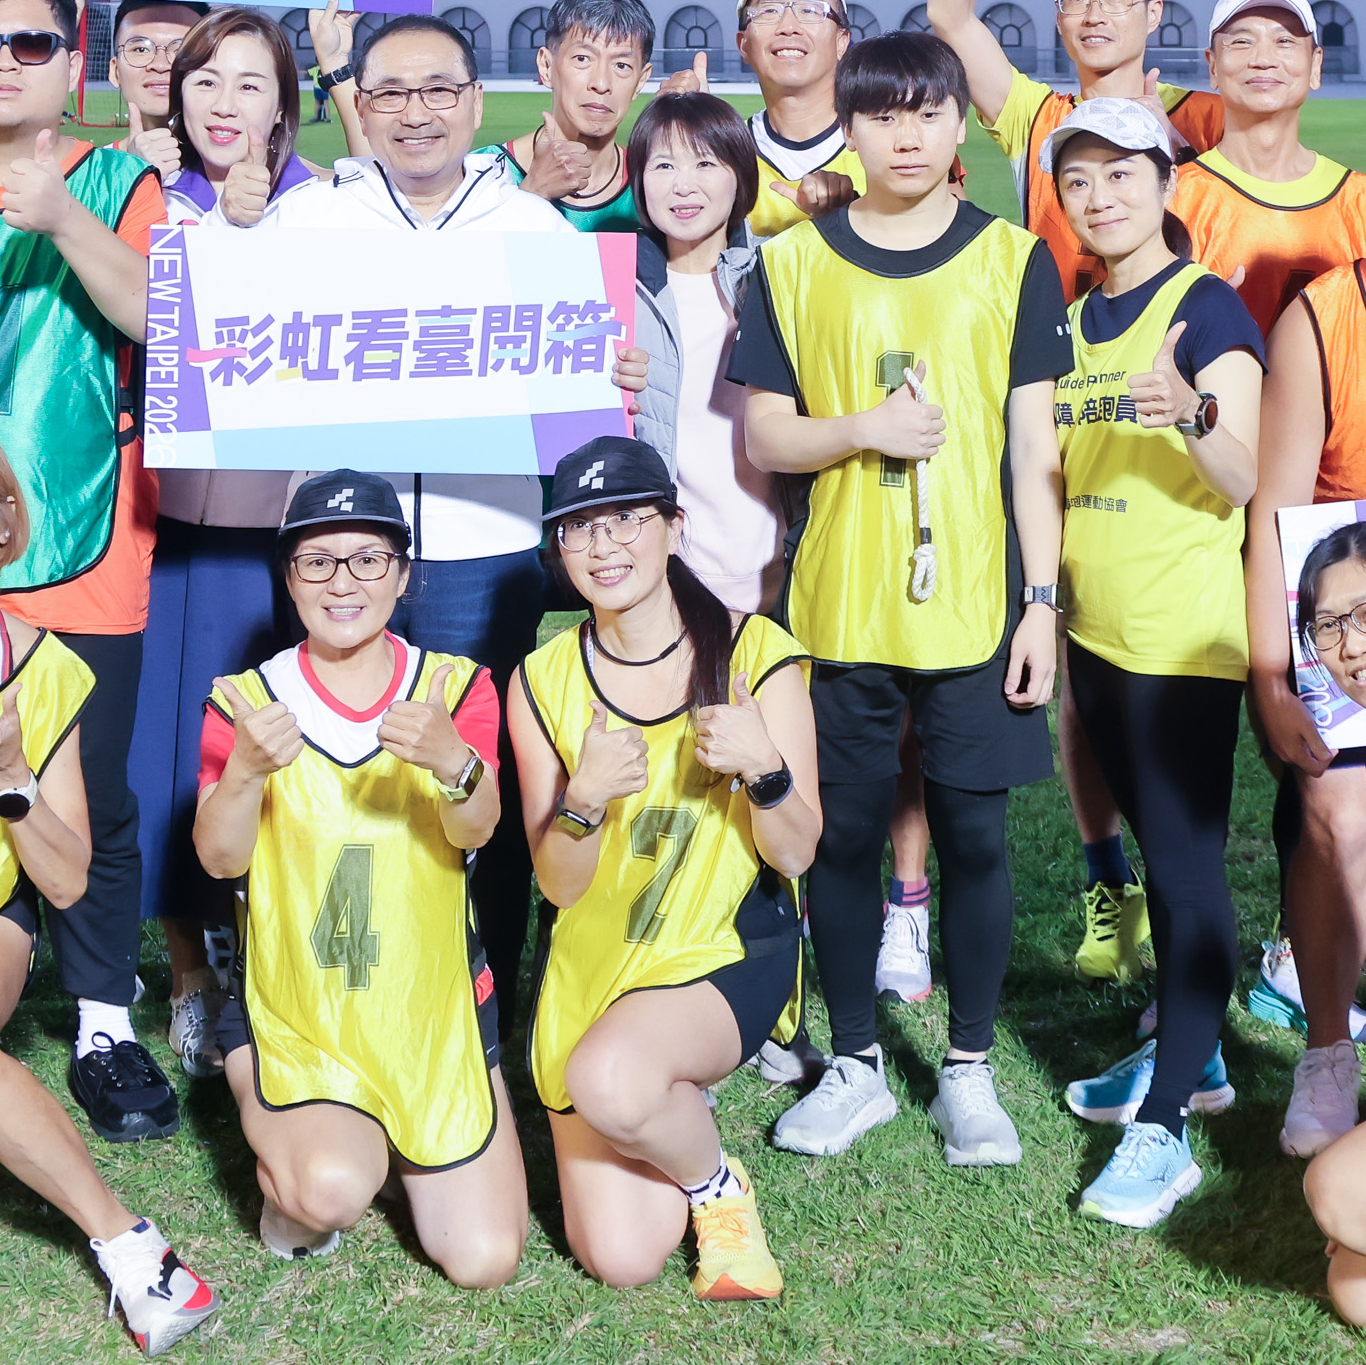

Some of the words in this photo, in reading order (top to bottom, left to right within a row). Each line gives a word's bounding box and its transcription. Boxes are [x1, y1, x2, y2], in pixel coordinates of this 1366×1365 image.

[149, 224, 183, 303] NEW
[145, 306, 179, 389] TAIPEI
[186, 300, 627, 387] 彩虹看臺開箱
[144, 395, 178, 467] 2026
[309, 844, 380, 991] 4
